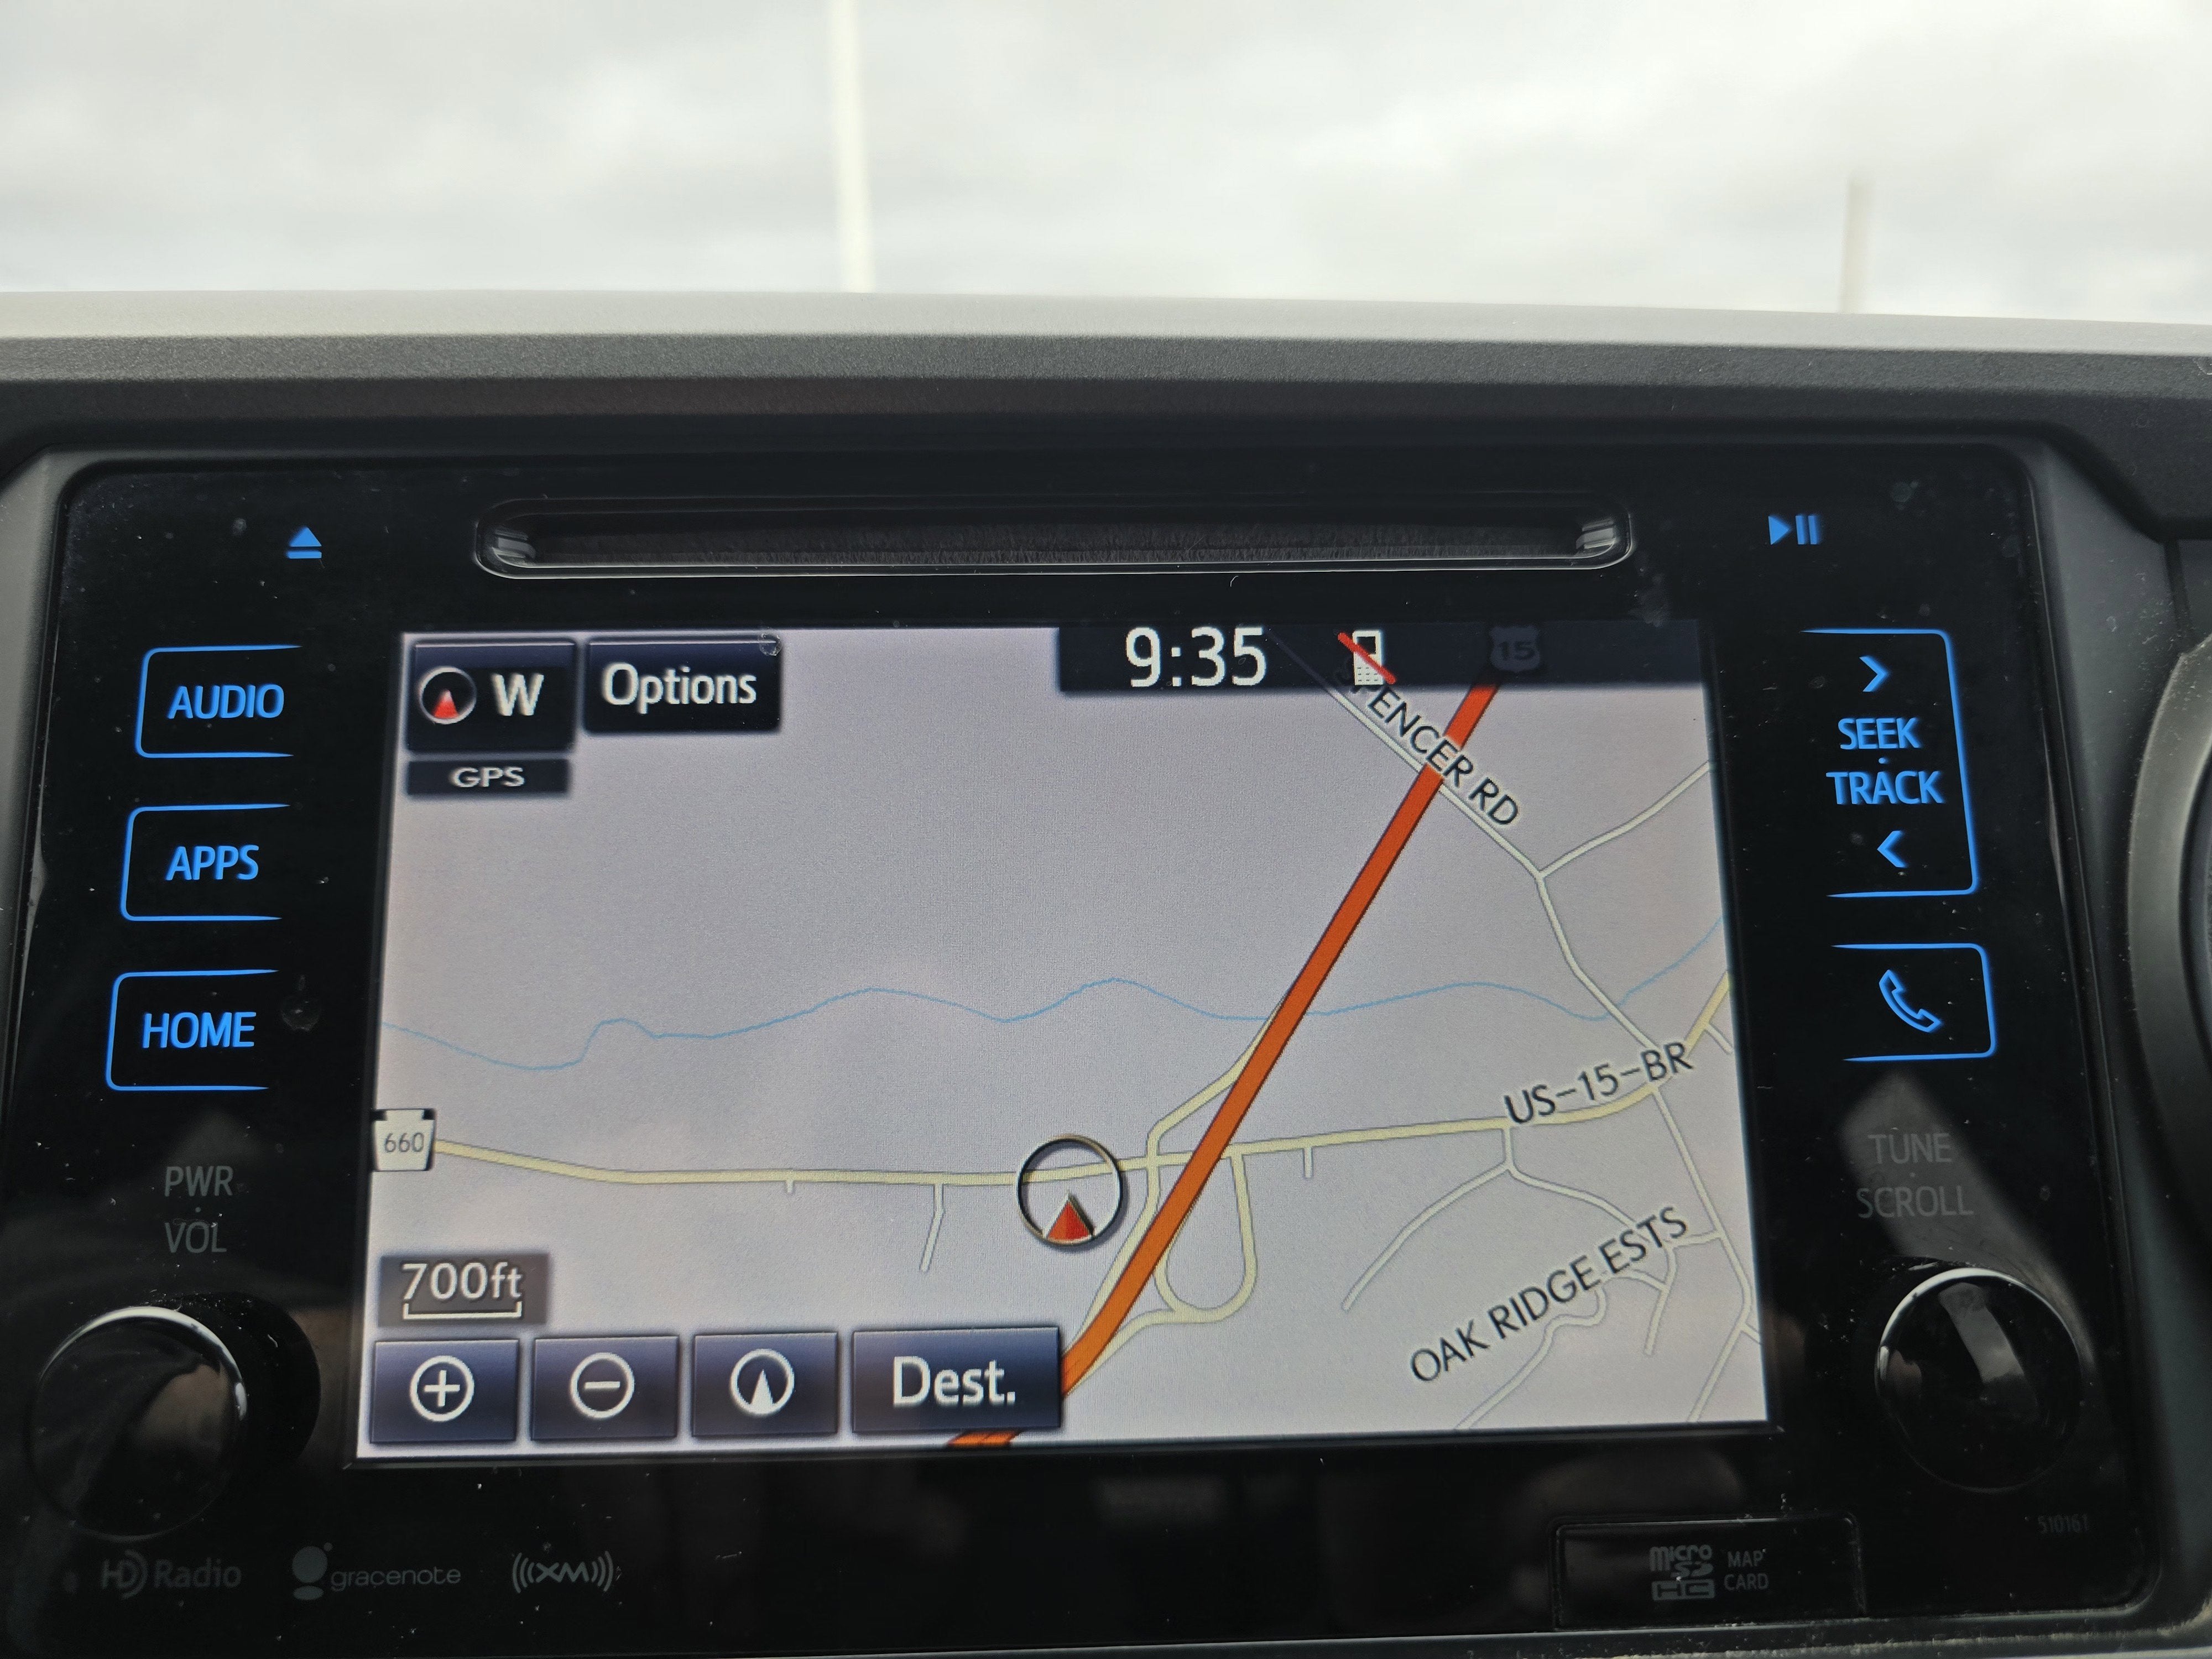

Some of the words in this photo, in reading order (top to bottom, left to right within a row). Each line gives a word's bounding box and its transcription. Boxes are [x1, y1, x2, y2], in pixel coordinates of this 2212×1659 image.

[1125, 627, 1267, 687] 9:35
[1498, 640, 1536, 661] 15
[167, 685, 285, 720] AUDIO
[491, 672, 544, 717] W
[603, 662, 757, 715] Options
[1333, 654, 1474, 788] ENCER
[1468, 777, 1519, 825] RD
[1838, 717, 1922, 750] SEEK
[449, 766, 525, 788] GPS
[1825, 771, 1944, 805] TRACK
[166, 845, 260, 881] APPS
[142, 1012, 257, 1048] HOME
[1503, 1041, 1693, 1125] US-15-BR
[384, 1131, 425, 1153] 660
[1867, 1133, 1953, 1164] TUNE
[164, 1165, 234, 1197] PWR
[1856, 1185, 1975, 1218] SCROLL
[164, 1221, 227, 1254] VOL
[401, 1261, 522, 1302] 700ft
[1410, 1318, 1490, 1382] OAK
[1488, 1255, 1601, 1339] RIDGE
[1599, 1206, 1688, 1275] ESTS
[893, 1355, 1016, 1408] Dest.
[154, 1558, 242, 1588] Radio
[1649, 1544, 1713, 1572] micro
[1727, 1550, 1764, 1568] MAP
[330, 1566, 461, 1592] gracenote
[1724, 1572, 1769, 1591] CARD
